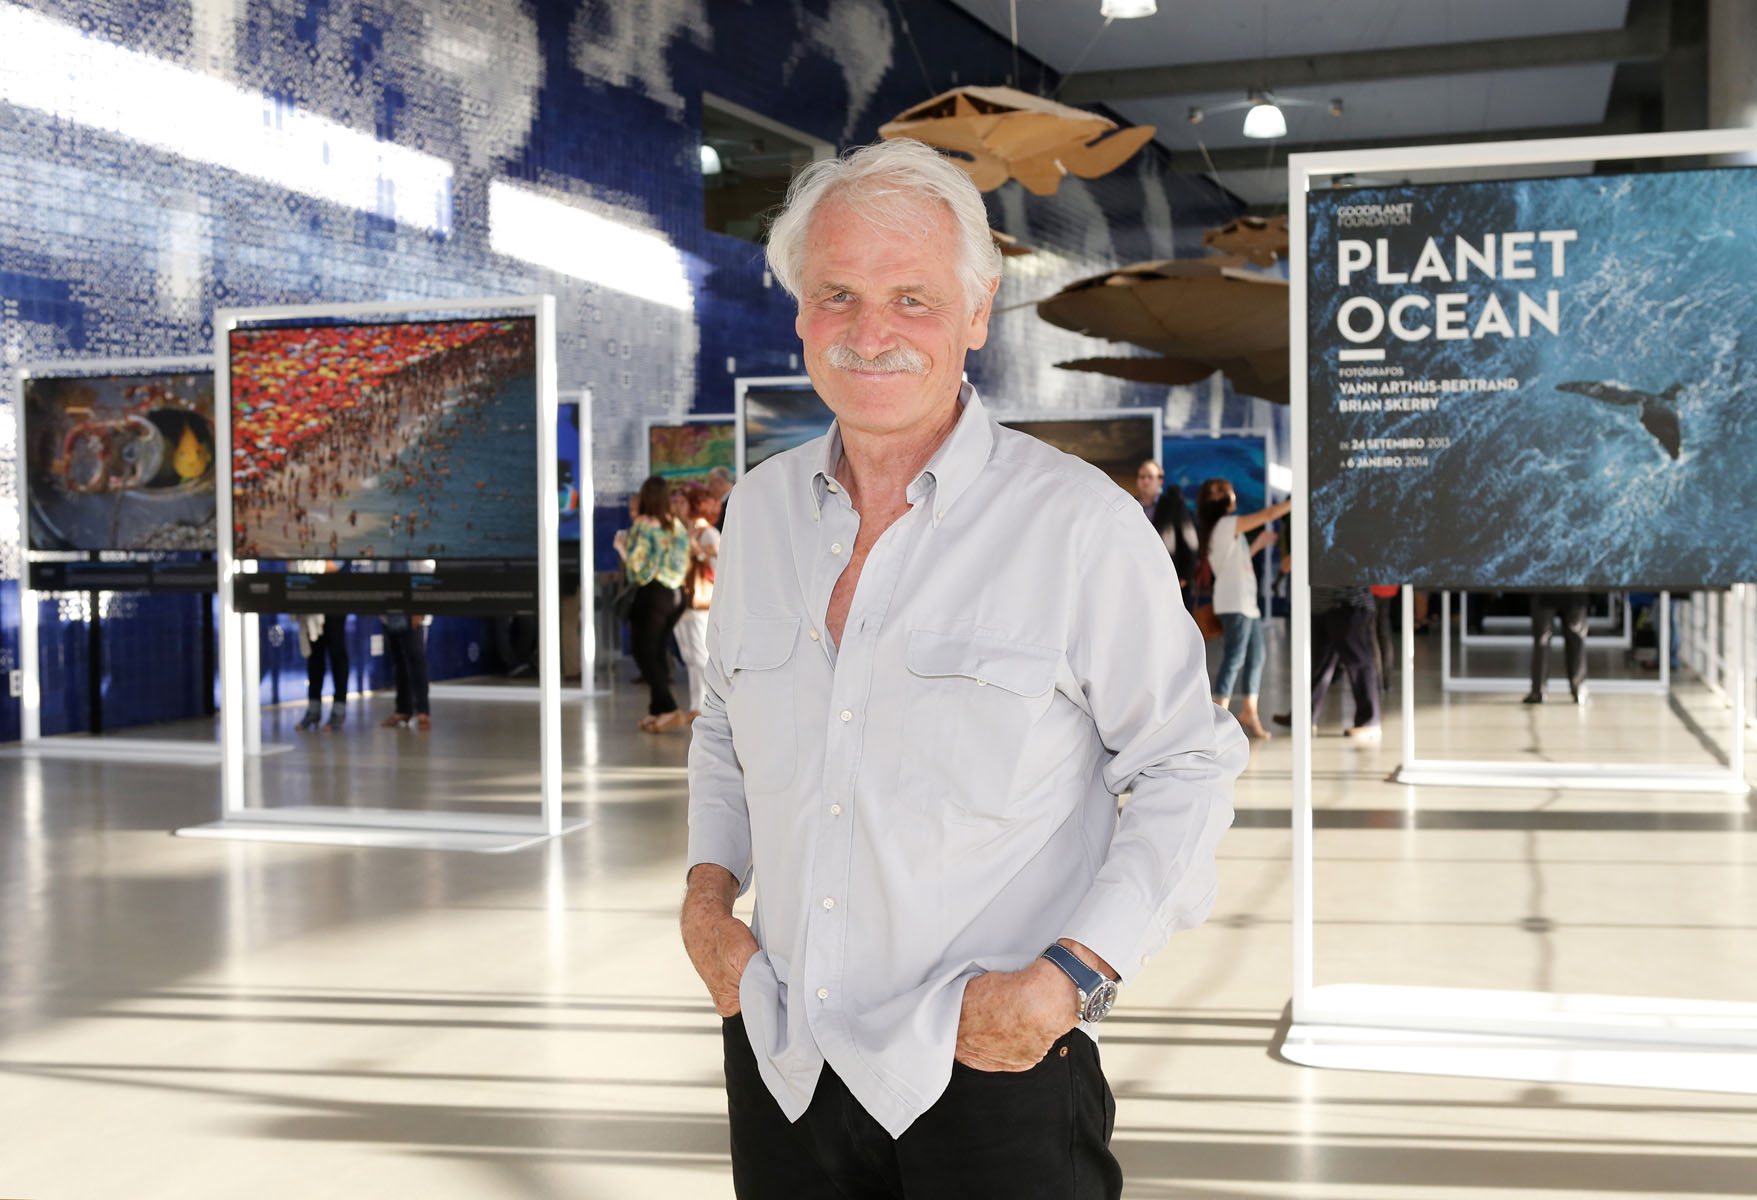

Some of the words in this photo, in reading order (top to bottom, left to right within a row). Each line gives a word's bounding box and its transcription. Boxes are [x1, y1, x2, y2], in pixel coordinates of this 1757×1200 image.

[1337, 202, 1413, 217] GOODPLANET
[1337, 214, 1411, 227] FOUNDATION
[1337, 229, 1578, 286] PLANET
[1337, 290, 1560, 343] OCEAN
[1338, 366, 1404, 378] FOTÓGRAFOS
[1338, 381, 1378, 395] YANN
[1380, 378, 1519, 394] ARTHUS-BERTRAND
[1339, 398, 1382, 413] BRIAN
[1384, 397, 1439, 412] SKERRY
[1351, 438, 1365, 450] 24
[1366, 437, 1425, 450] SETEMBRO
[1428, 437, 1451, 449] 2013
[1346, 456, 1355, 468] 6
[1356, 456, 1402, 468] JANEIRO
[1405, 456, 1429, 467] 2014
